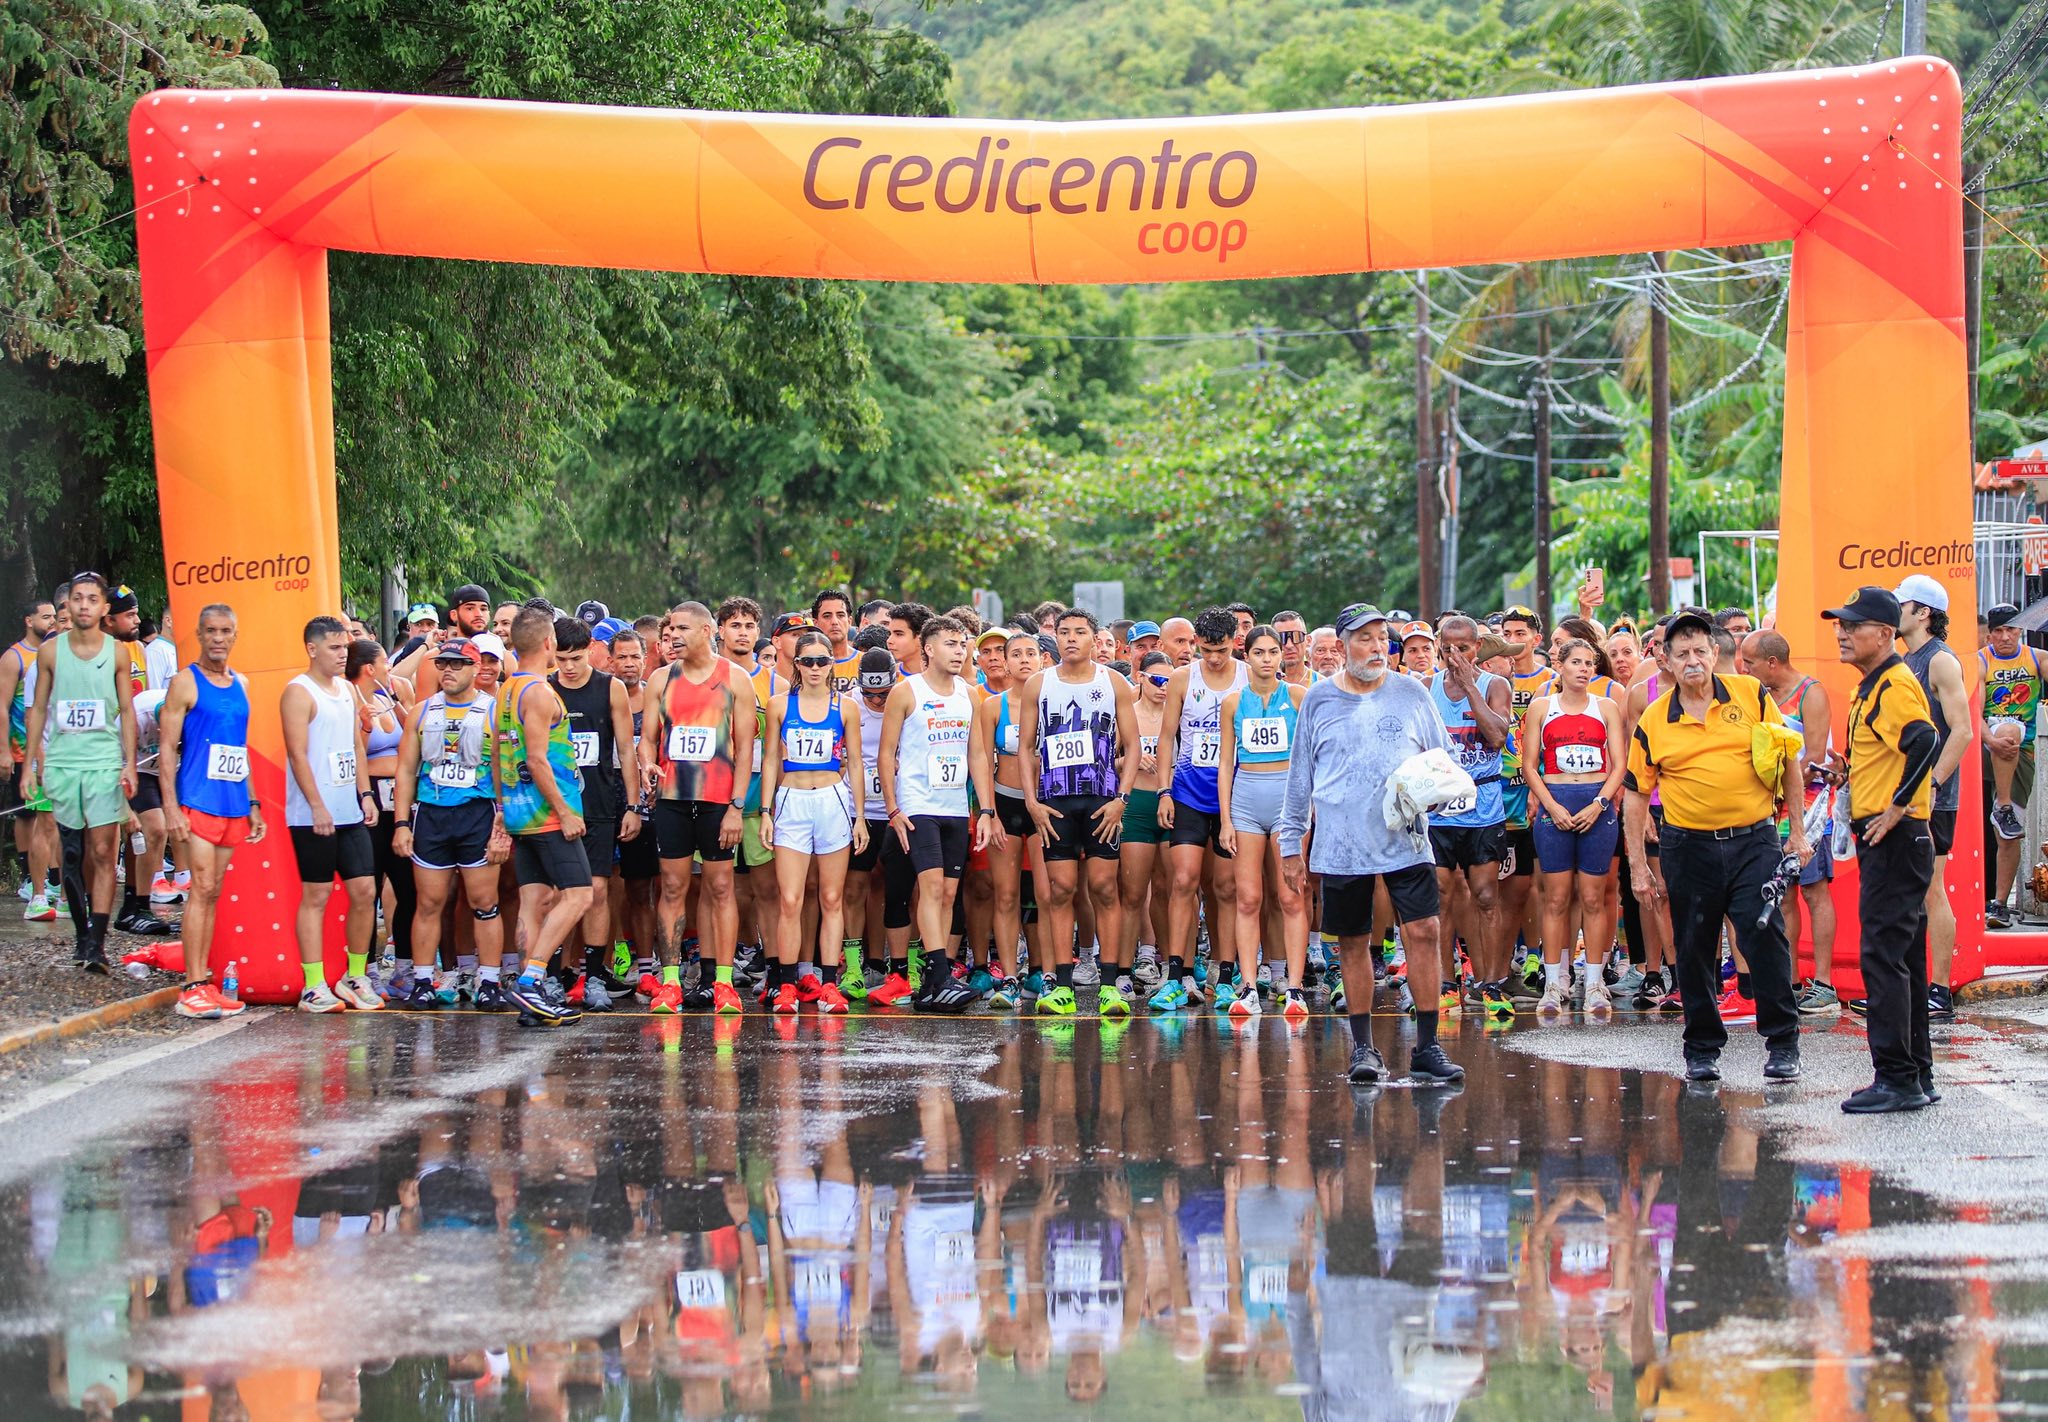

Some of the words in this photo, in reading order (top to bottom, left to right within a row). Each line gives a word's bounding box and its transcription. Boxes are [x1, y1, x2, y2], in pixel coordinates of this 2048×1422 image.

[802, 136, 1258, 215] Credicentro
[1137, 218, 1248, 263] coop
[2021, 465, 2042, 474] AVE.
[1838, 540, 1974, 570] Credicentro
[2024, 539, 2048, 564] PARE
[172, 553, 311, 586] Credicentro
[1948, 567, 1973, 581] coop
[275, 578, 309, 592] coop
[1994, 666, 2029, 681] CEPA
[67, 709, 95, 727] 457
[680, 736, 706, 754] 157
[928, 731, 968, 742] OLDAC
[1064, 732, 1084, 740] CEPA
[1251, 727, 1279, 746] 495
[796, 739, 824, 756] 174
[1056, 740, 1085, 760] 280
[1200, 743, 1219, 761] 37
[218, 754, 244, 775] 202
[338, 759, 356, 779] 376
[1566, 754, 1595, 768] 414
[441, 761, 466, 781] 136
[941, 764, 957, 782] 37
